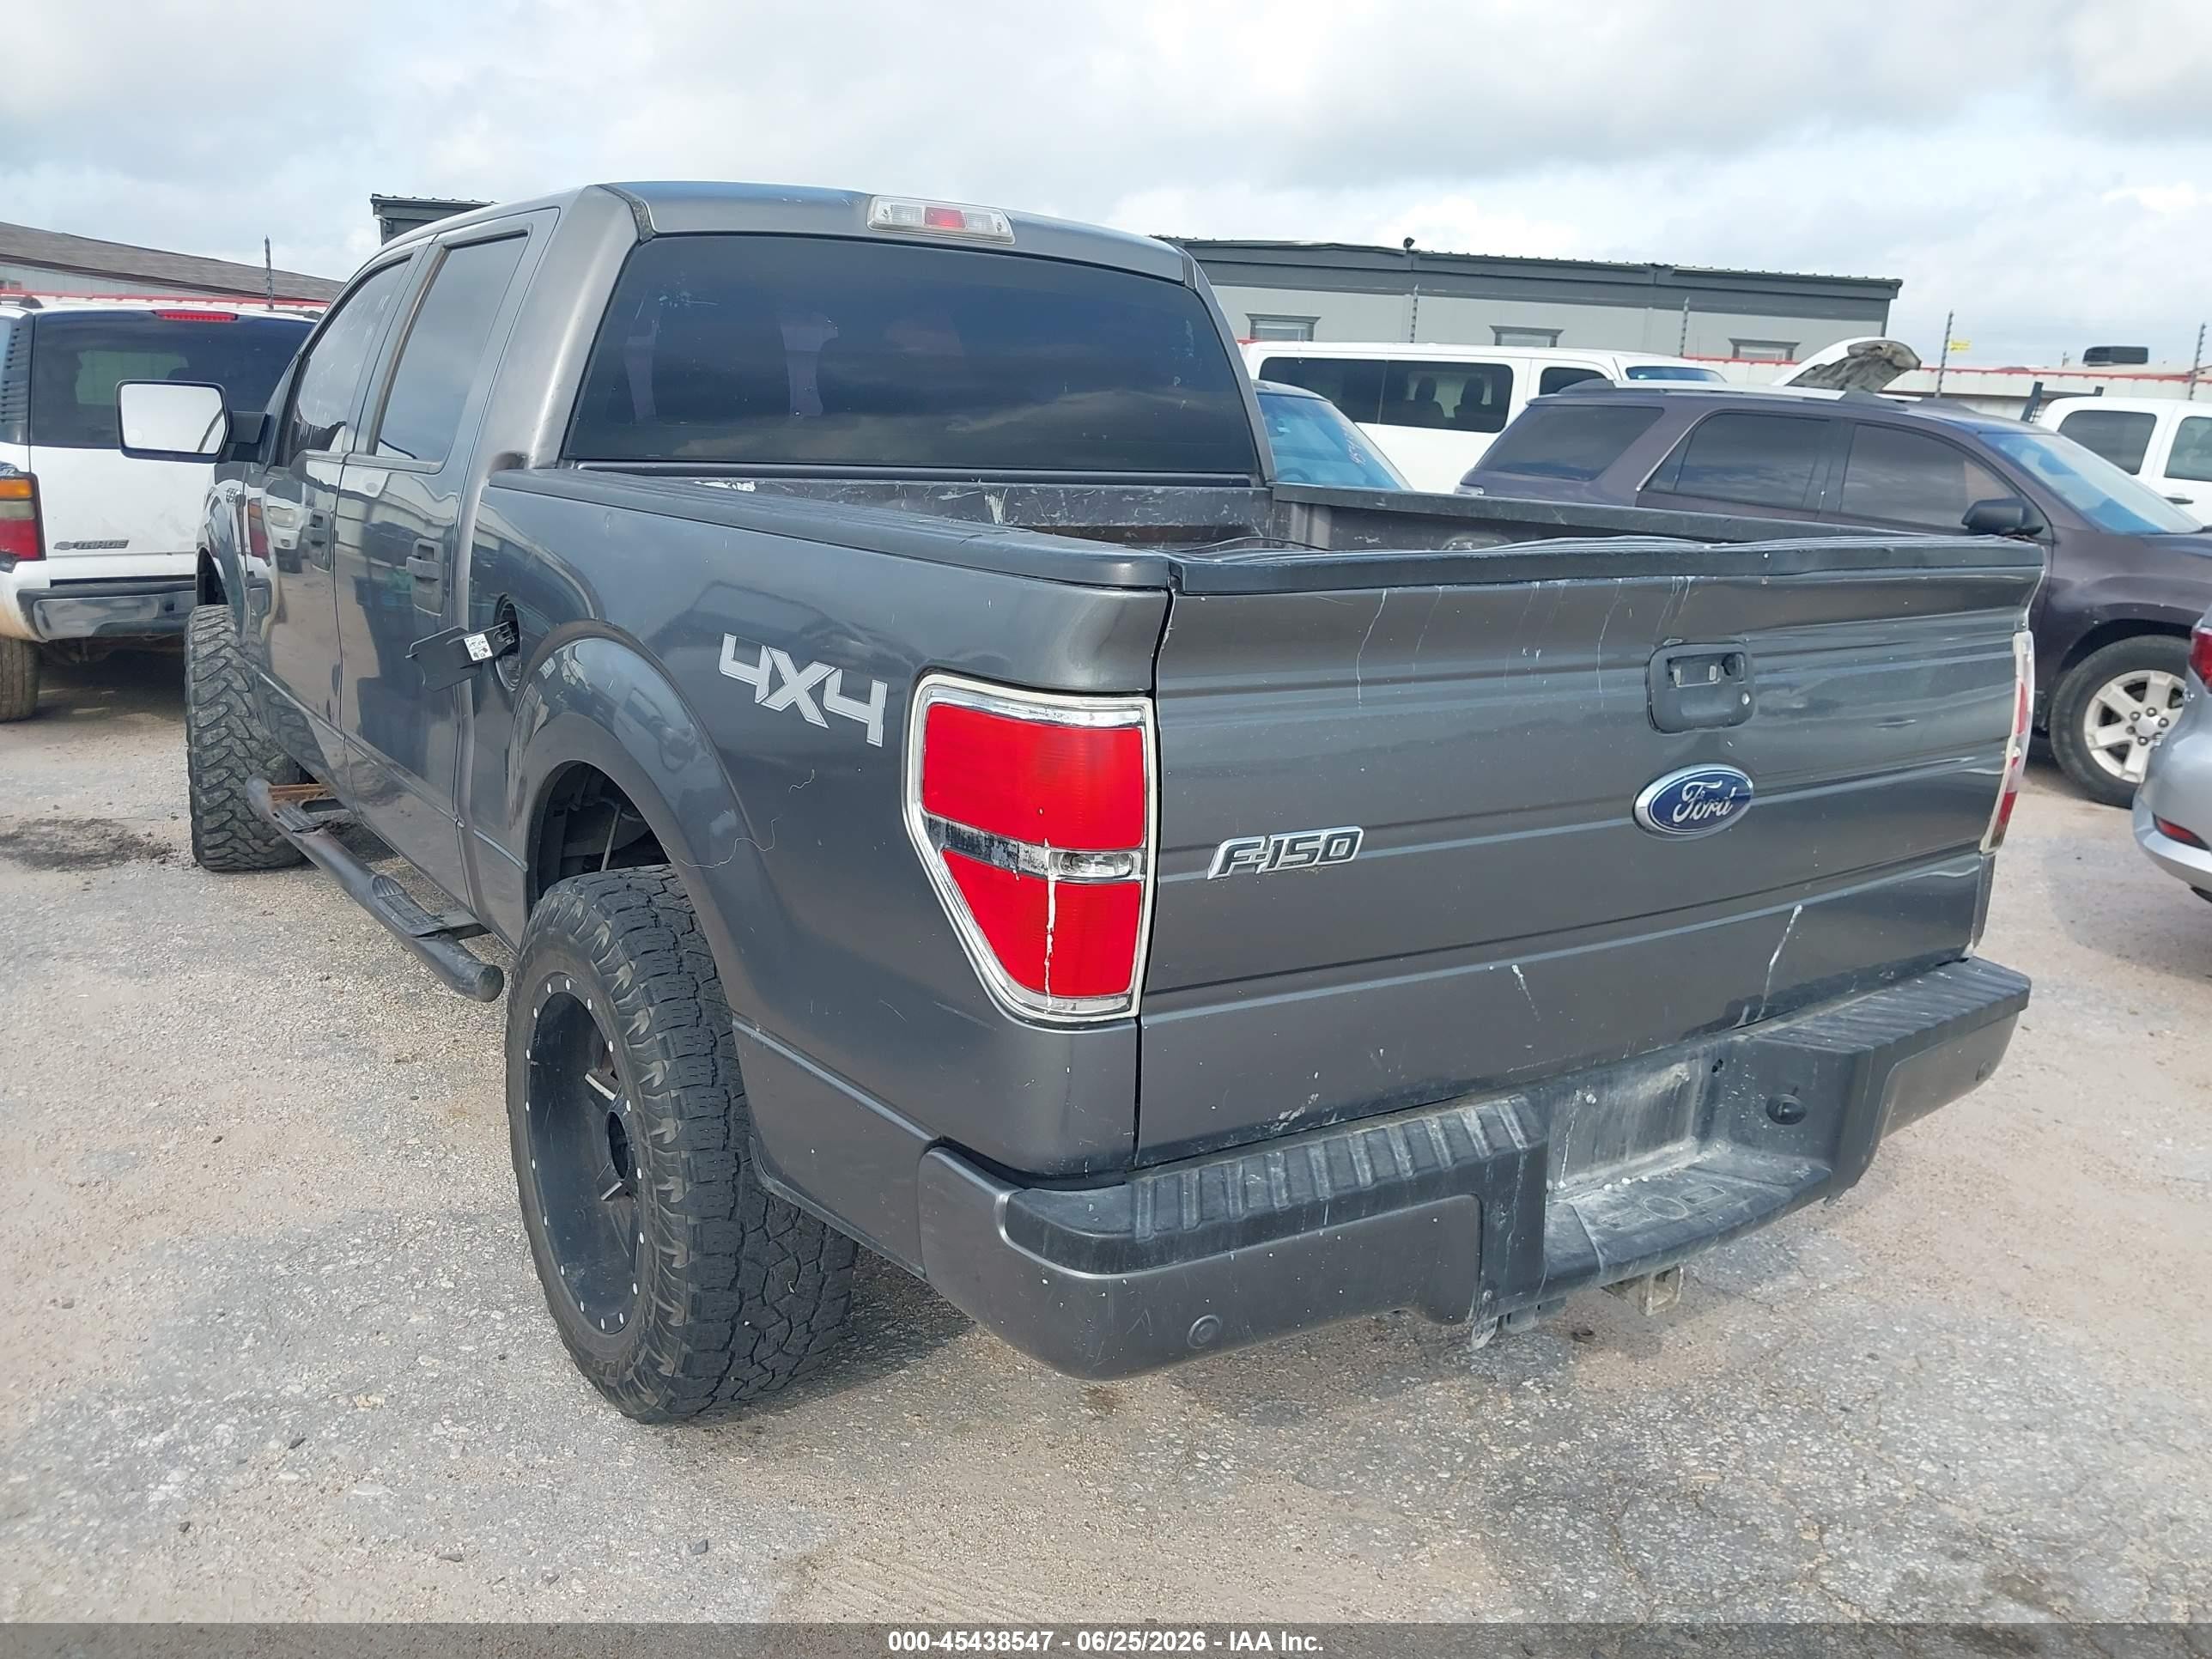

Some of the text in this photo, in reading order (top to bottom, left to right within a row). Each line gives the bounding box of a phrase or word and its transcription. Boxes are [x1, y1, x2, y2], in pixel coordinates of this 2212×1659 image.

[75, 539, 129, 550] TAHOE
[1673, 780, 1737, 823] Ford
[1206, 826, 1364, 879] F-150
